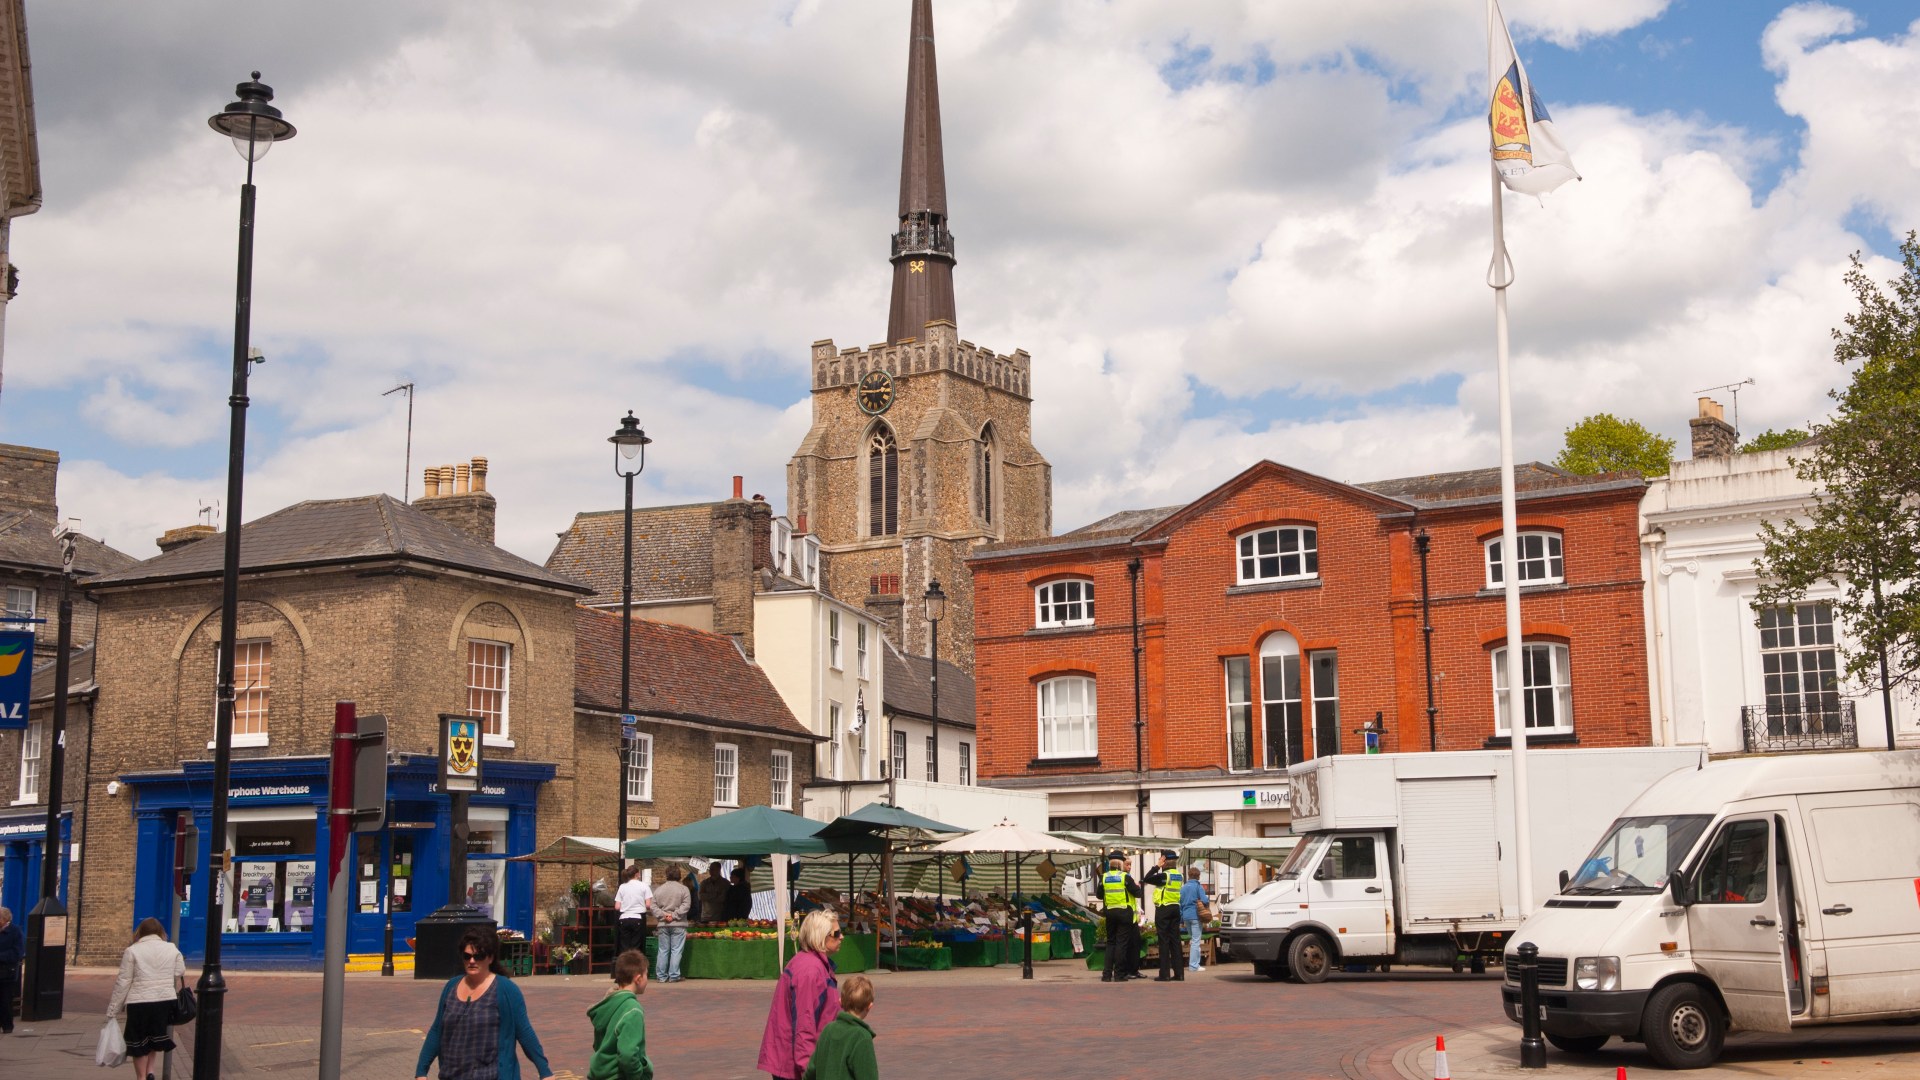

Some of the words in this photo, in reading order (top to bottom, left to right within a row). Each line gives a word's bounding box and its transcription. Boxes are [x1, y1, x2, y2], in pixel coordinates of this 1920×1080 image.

[58, 730, 65, 748] 4
[228, 786, 260, 797] rphone
[261, 785, 309, 794] Warehouse
[481, 785, 505, 794] ehouse
[1260, 790, 1290, 805] Lloyd
[0, 825, 18, 835] arphone
[19, 824, 46, 833] Warehouse
